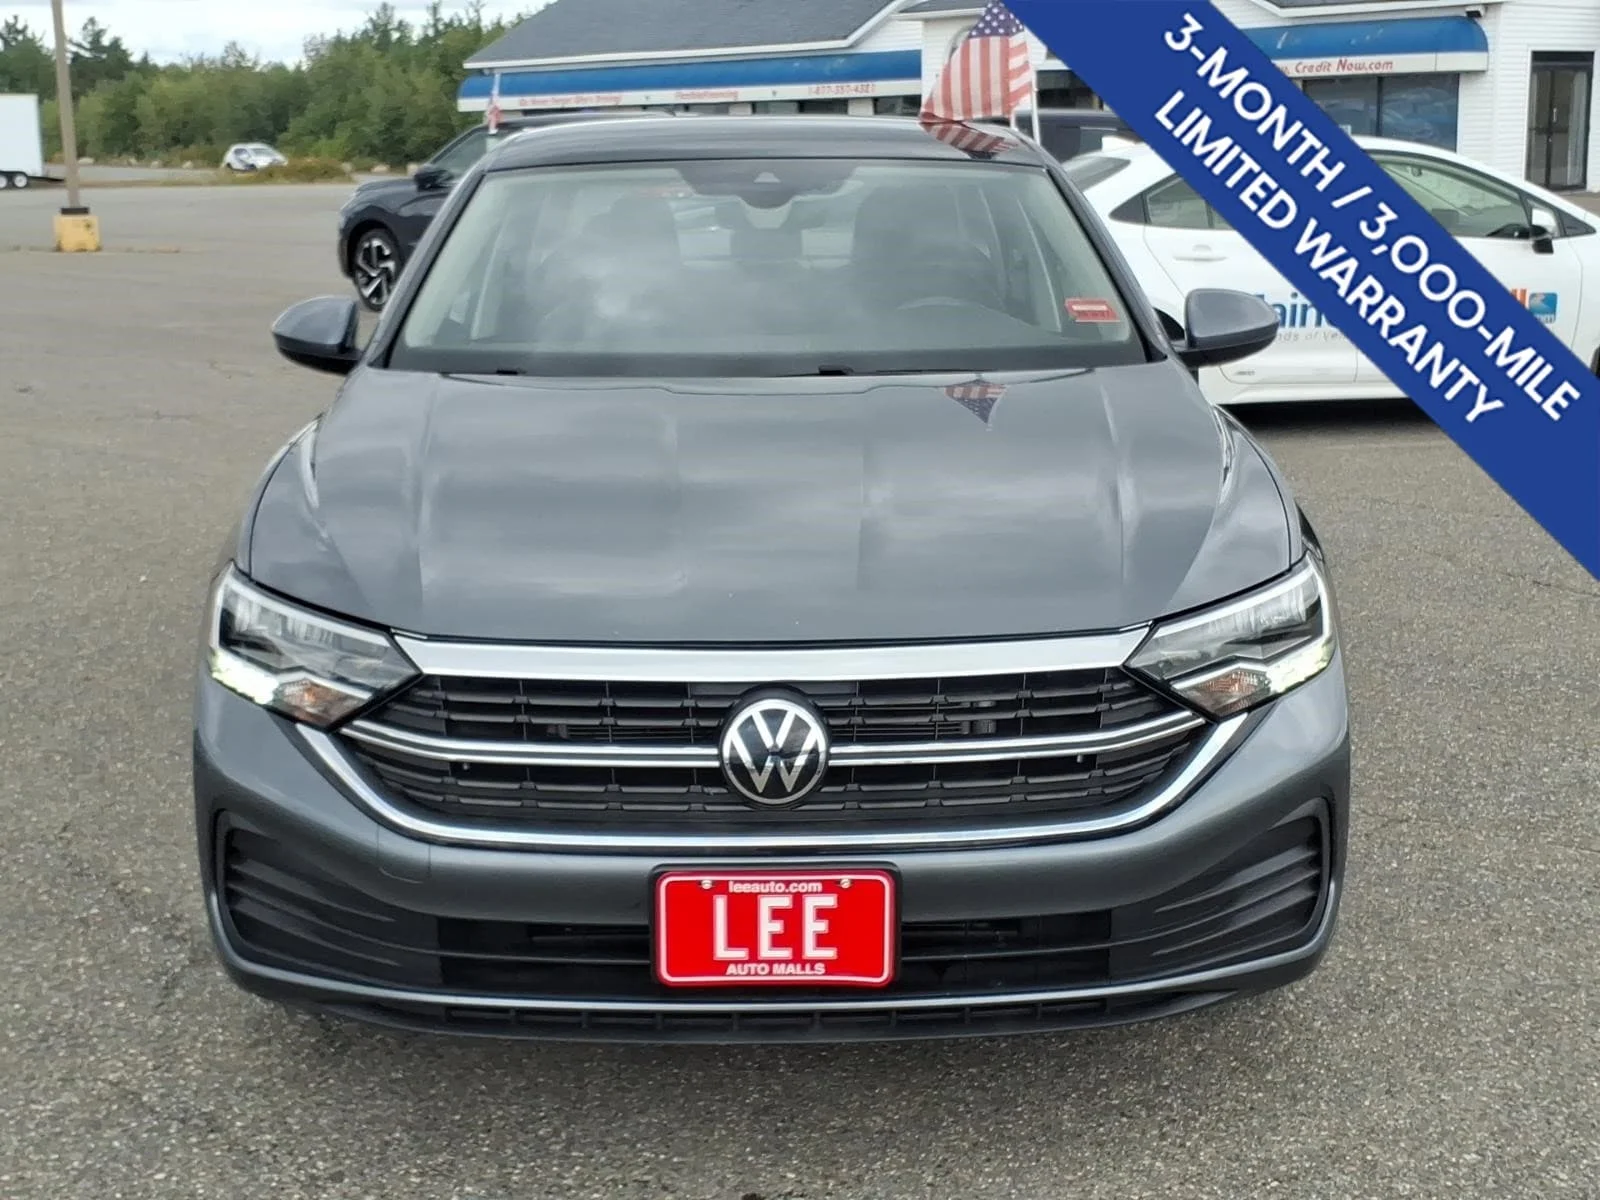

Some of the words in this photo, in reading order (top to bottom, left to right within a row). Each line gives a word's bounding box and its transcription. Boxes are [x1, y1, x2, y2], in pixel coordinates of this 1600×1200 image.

[1295, 62, 1331, 73] Credit
[1336, 58, 1393, 72] Now.com
[728, 880, 823, 893] leeauto.com
[713, 894, 838, 960] LEE
[726, 963, 770, 976] AUTO
[772, 963, 826, 976] MALLS
